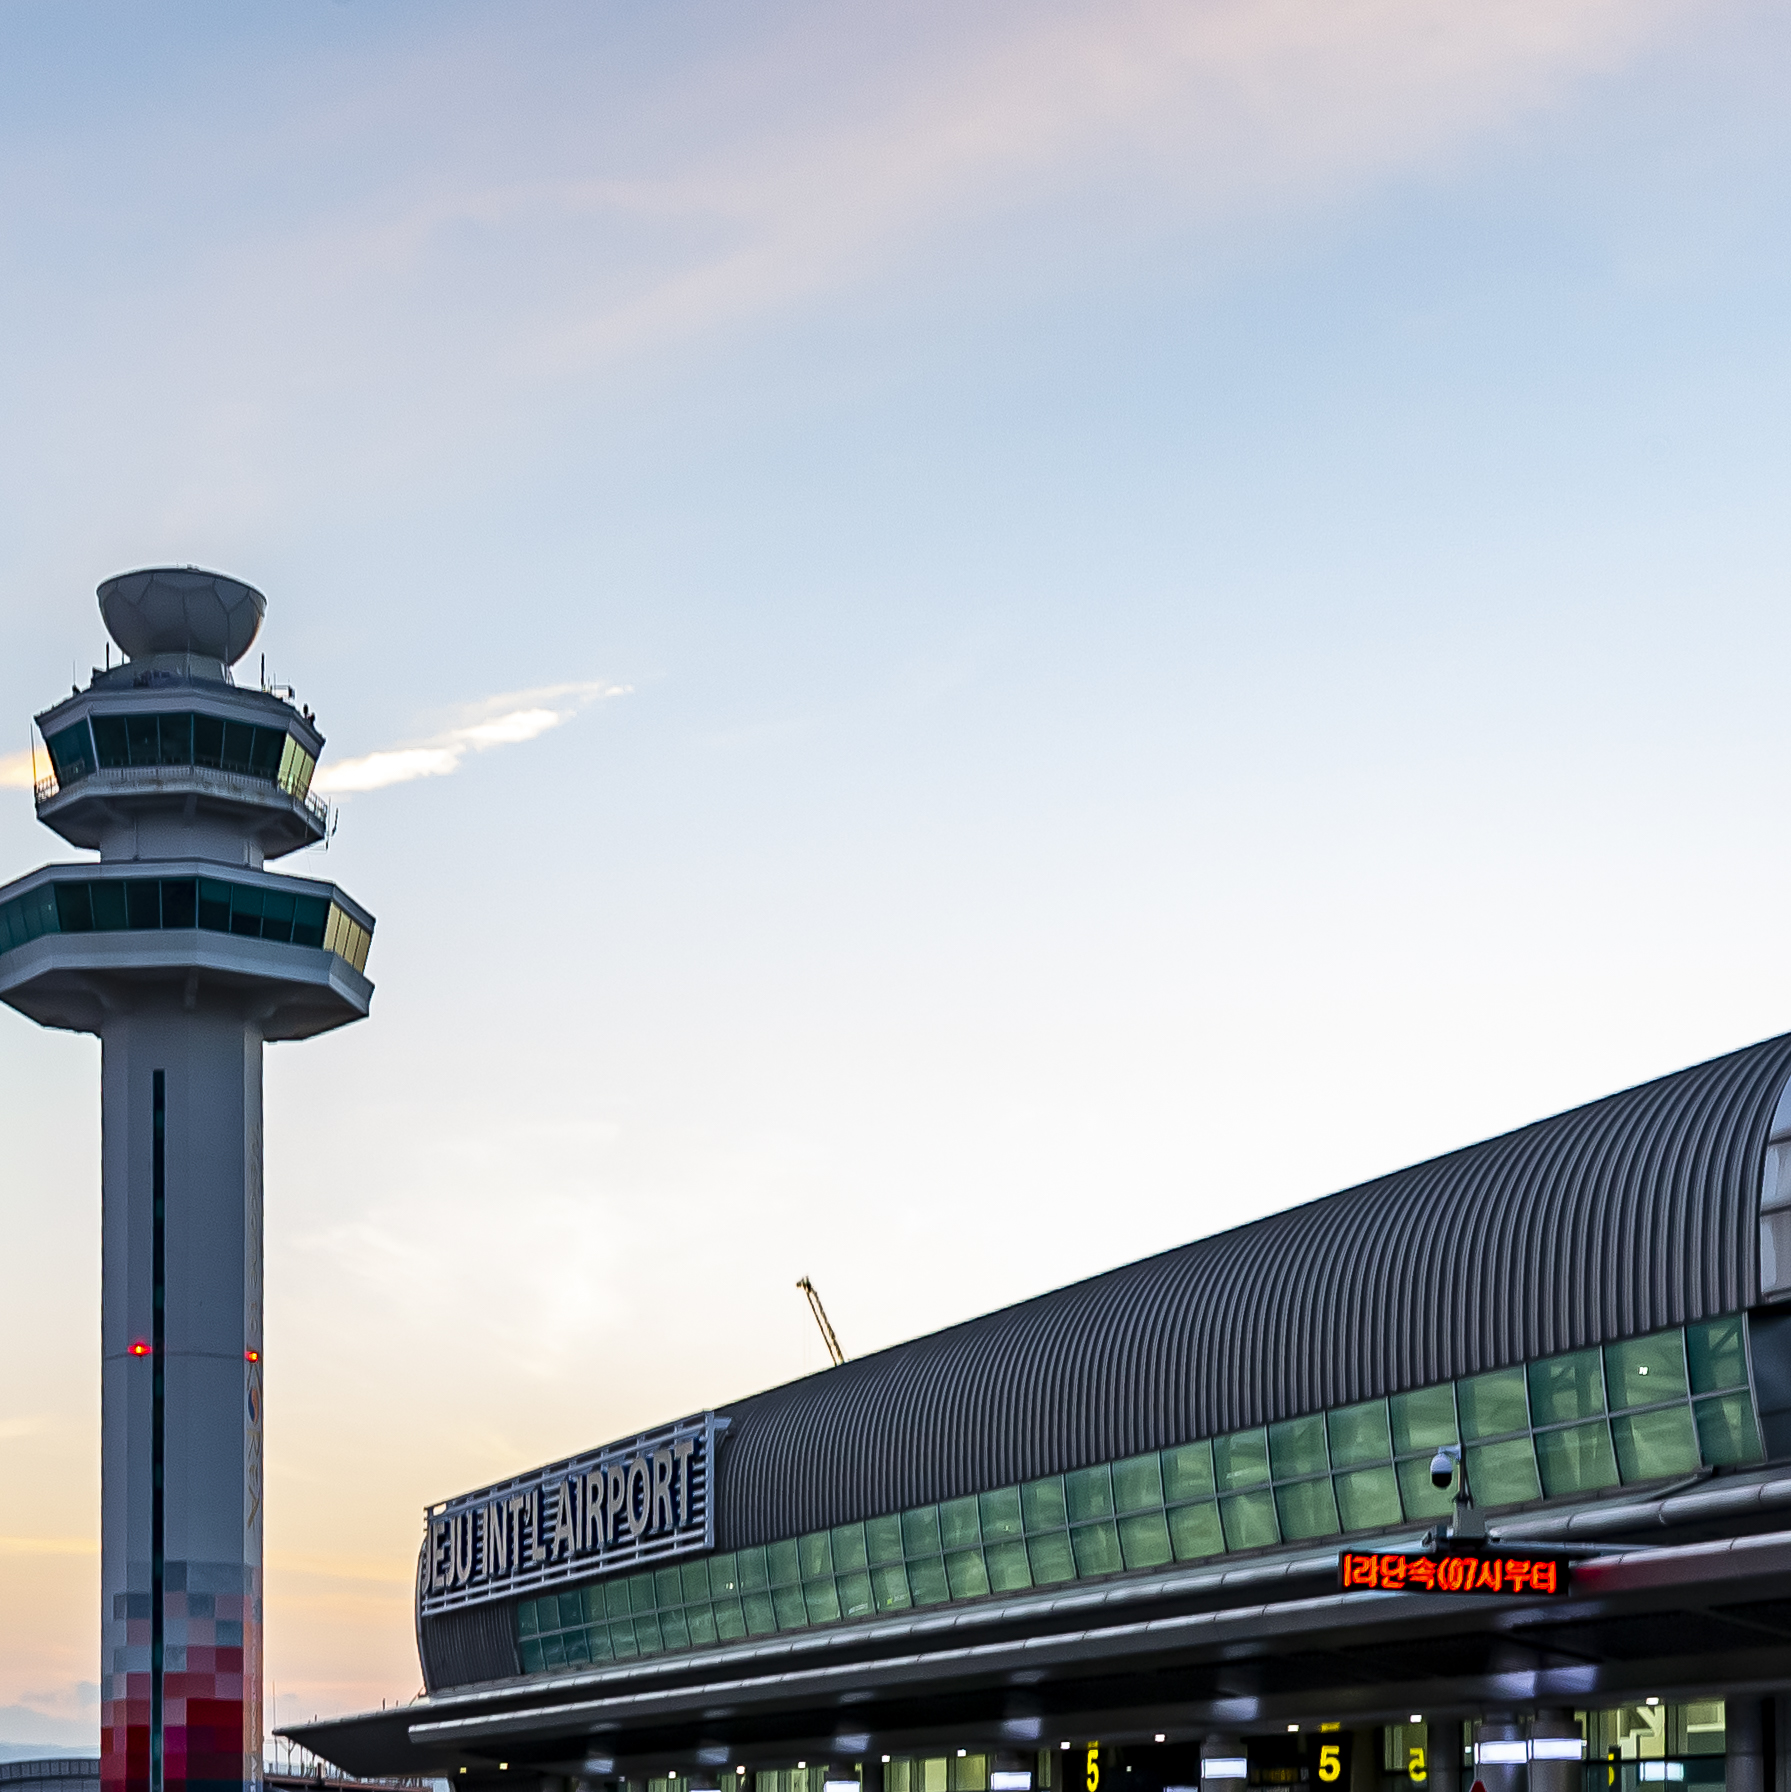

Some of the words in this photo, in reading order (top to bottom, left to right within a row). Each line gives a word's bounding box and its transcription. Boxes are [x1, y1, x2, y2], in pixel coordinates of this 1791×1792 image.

[481, 1489, 546, 1578] INT'L
[552, 1437, 695, 1561] AIRPORT
[1343, 1553, 1557, 1593] 라단속(07시부터
[1086, 1749, 1100, 1792] 5
[1319, 1745, 1341, 1782] 5
